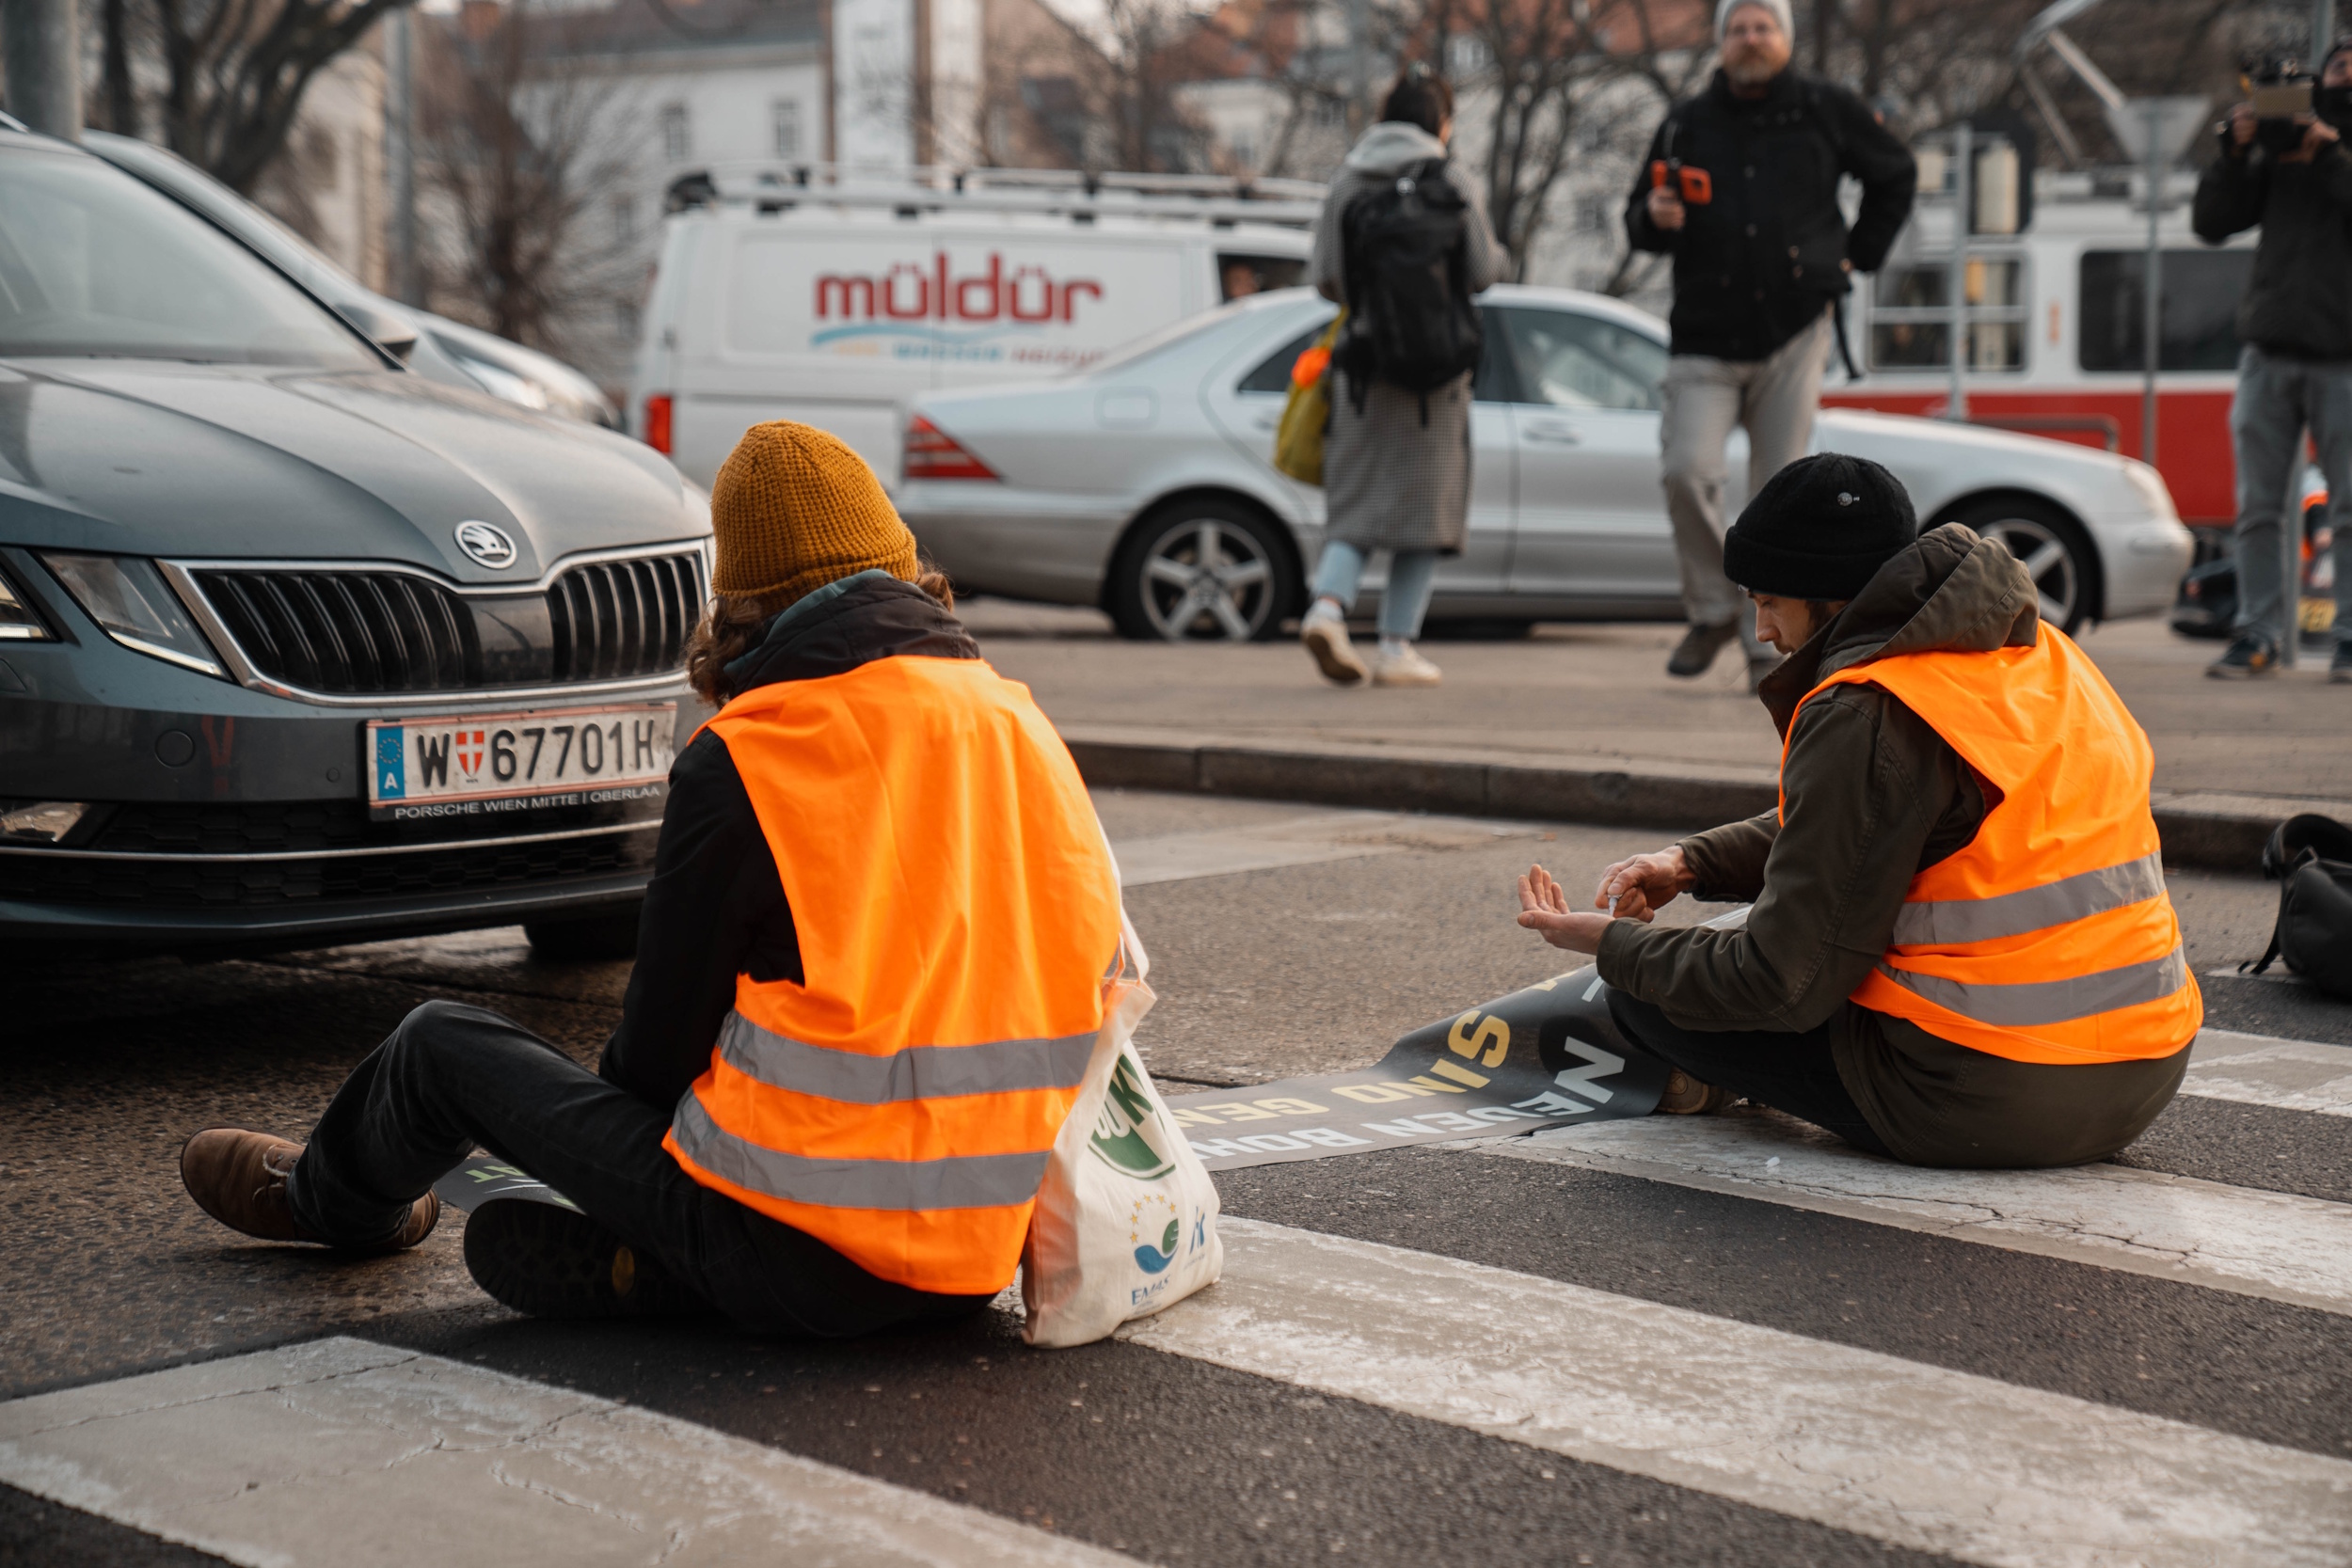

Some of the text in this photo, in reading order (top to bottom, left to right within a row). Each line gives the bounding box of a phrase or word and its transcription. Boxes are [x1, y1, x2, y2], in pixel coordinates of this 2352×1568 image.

[815, 250, 1103, 323] müldür
[383, 771, 399, 790] A
[417, 733, 450, 787] W
[395, 801, 480, 819] PORSCHE
[484, 799, 528, 813] WIEN
[531, 793, 579, 809] MITTE
[590, 785, 660, 803] OBERLAA
[1172, 1010, 1511, 1128] SIND GEN
[1189, 1036, 1626, 1161] NEUEN BOH
